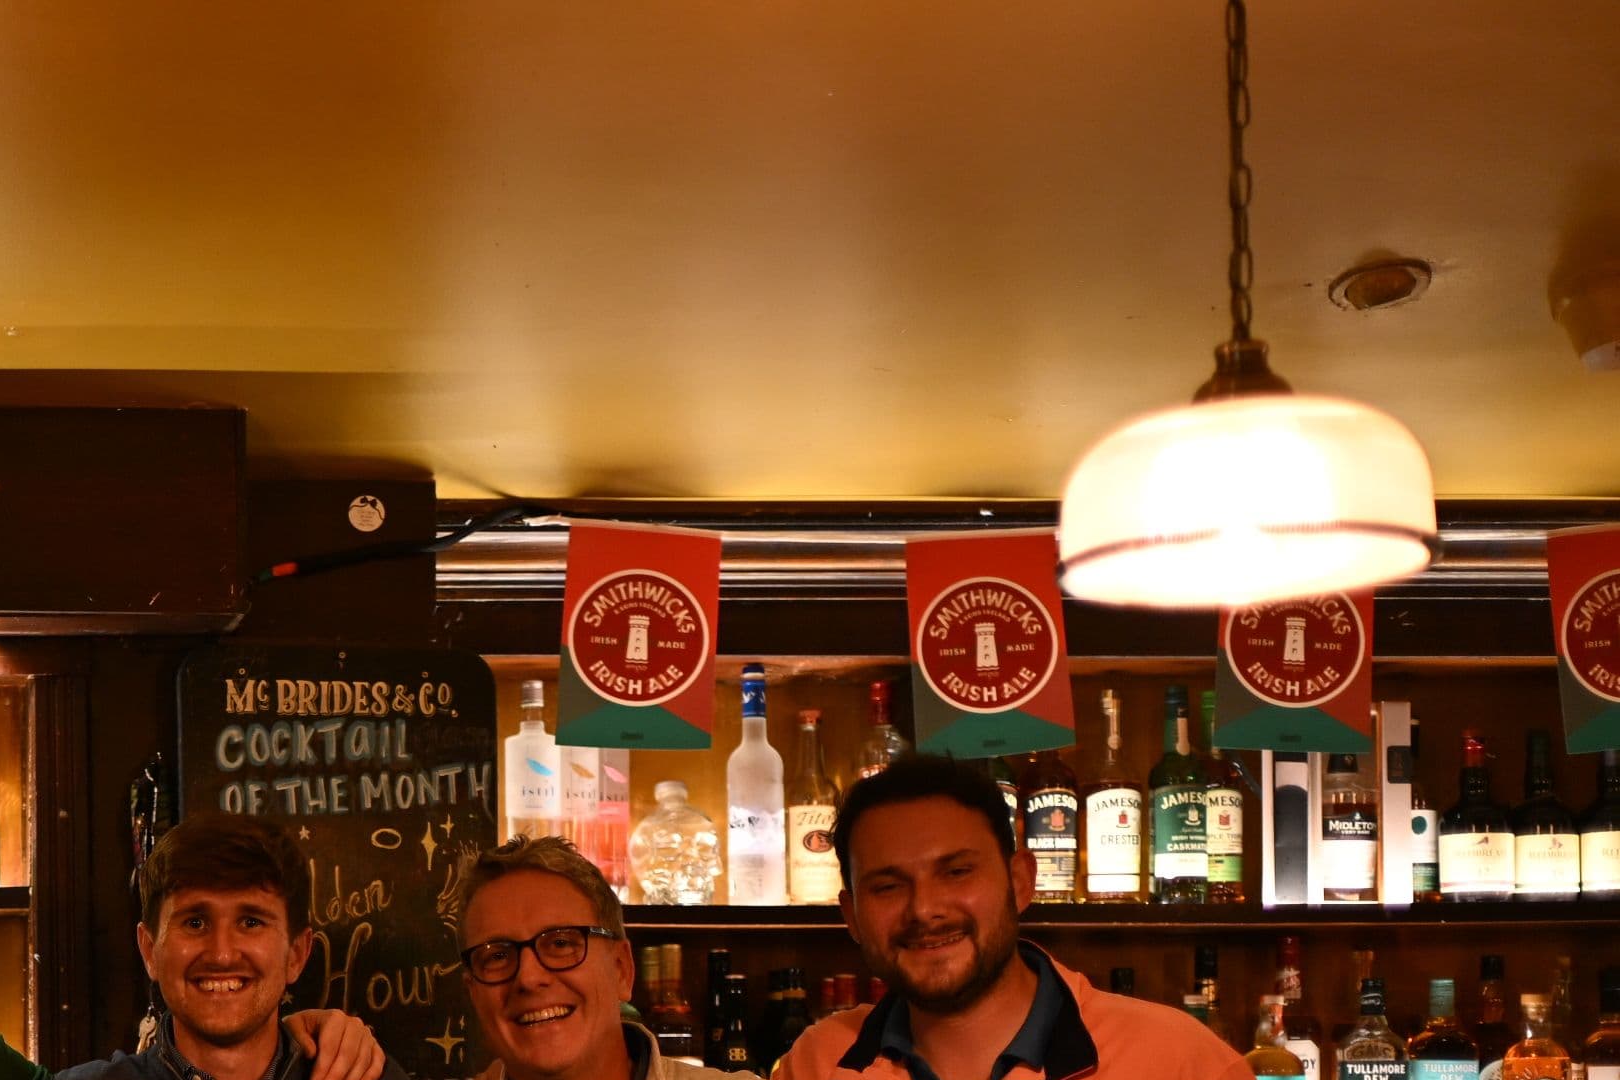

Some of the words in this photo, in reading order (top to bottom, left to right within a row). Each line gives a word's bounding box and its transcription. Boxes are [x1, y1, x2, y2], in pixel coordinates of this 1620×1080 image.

[1574, 582, 1620, 633] SMITH
[590, 636, 618, 645] IRISH
[657, 641, 686, 650] MADE
[939, 648, 966, 656] IRISH
[1006, 643, 1035, 652] MADE
[1315, 642, 1342, 650] MADE
[589, 660, 643, 695] IRISH
[648, 664, 684, 694] ALE
[942, 672, 998, 702] IRISH
[1002, 667, 1037, 698] ALE
[1247, 661, 1300, 697] IRISH
[1306, 666, 1341, 695] ALE
[275, 679, 390, 716] BRIDES
[221, 776, 266, 816] OF
[275, 774, 349, 816] THE
[360, 761, 493, 813] MONTH
[1094, 797, 1140, 813] JAMESO
[310, 858, 393, 925] lden
[313, 921, 462, 1010] Hour
[1347, 1064, 1406, 1075] TULLAMORE
